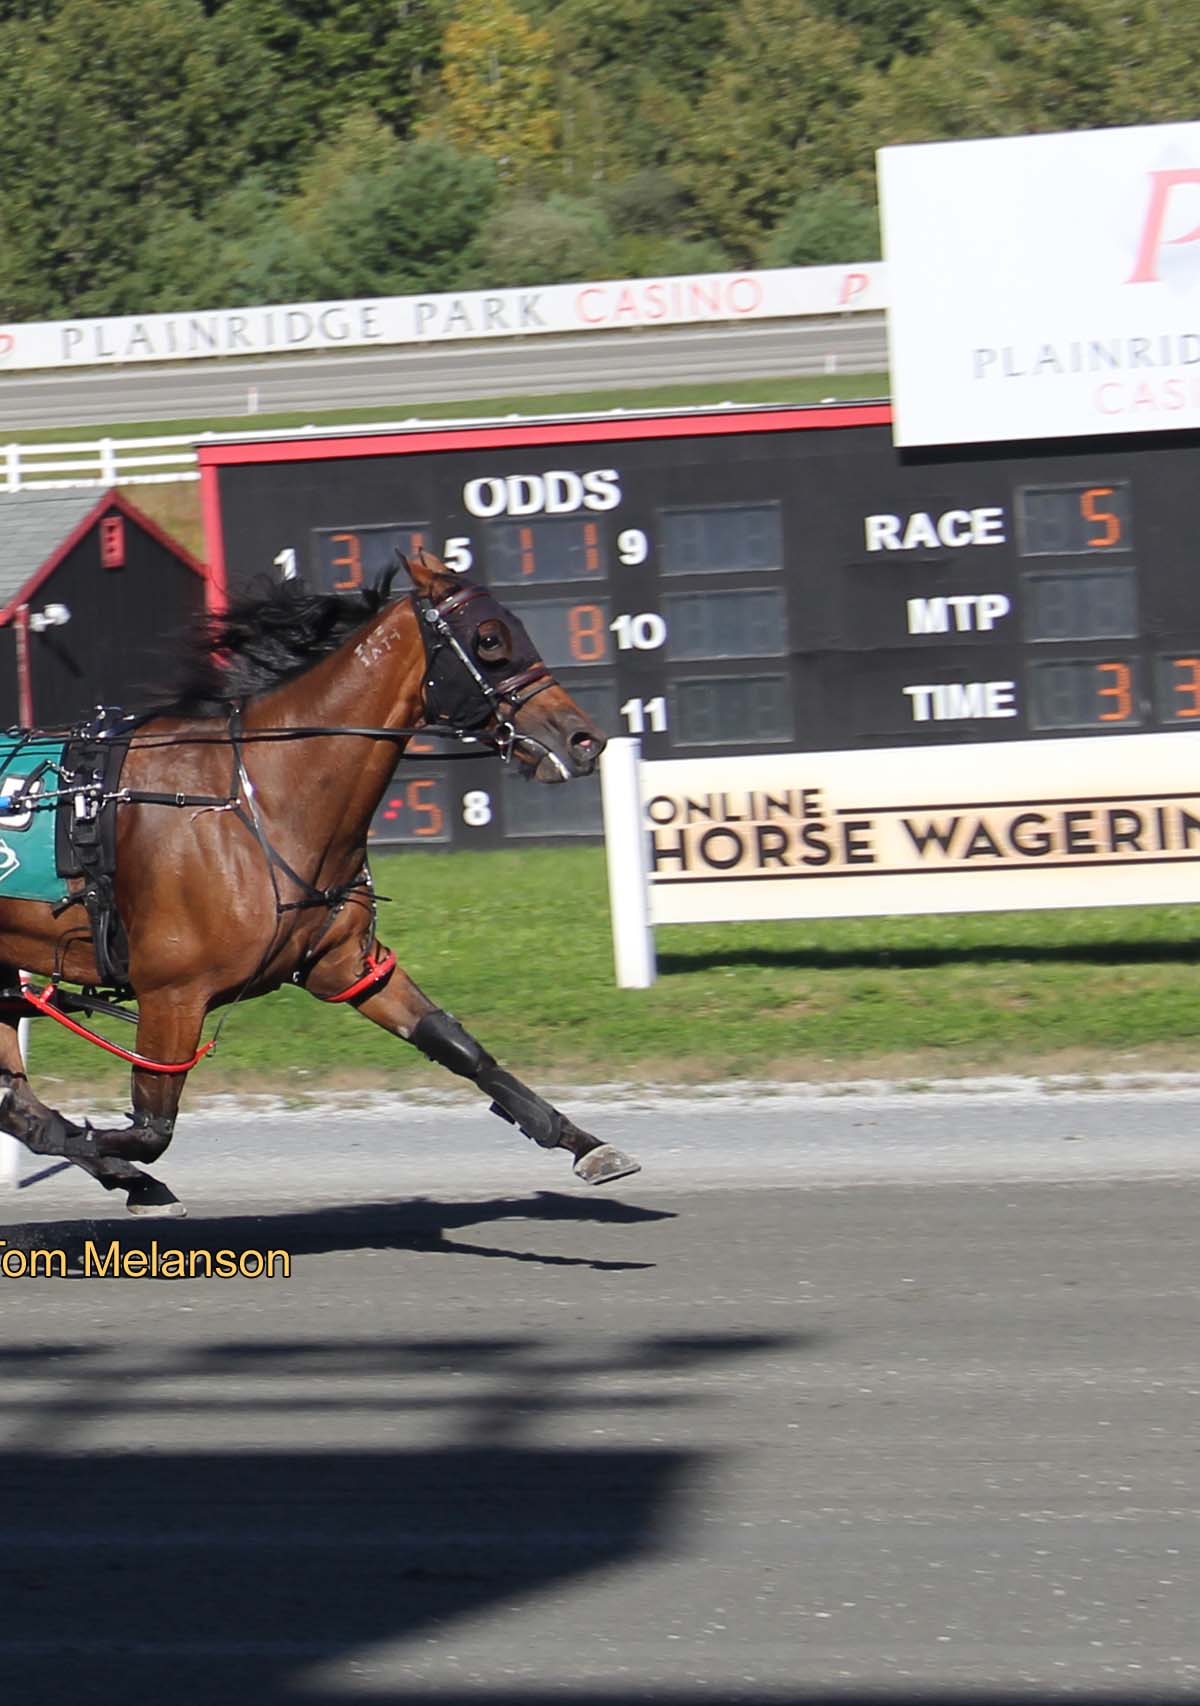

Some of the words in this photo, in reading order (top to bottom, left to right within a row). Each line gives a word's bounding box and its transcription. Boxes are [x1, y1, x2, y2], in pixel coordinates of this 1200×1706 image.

[837, 274, 870, 305] P
[61, 306, 382, 360] PLAINRIDGE
[413, 292, 547, 335] PARK
[576, 278, 764, 323] CASINO
[463, 469, 622, 518] ODDS
[865, 506, 1006, 552] RACE
[1079, 487, 1121, 547] 5
[273, 547, 297, 581] 1
[444, 537, 474, 574] 5
[617, 529, 648, 566] 9
[568, 604, 606, 661] 8
[609, 613, 667, 652] 10
[907, 593, 1010, 635] MTP
[902, 681, 1017, 722] TIME
[1096, 662, 1133, 721] 3
[620, 697, 668, 734] 11
[462, 789, 492, 827] 8
[648, 788, 822, 826] ONLINE
[649, 820, 876, 873] HORSE
